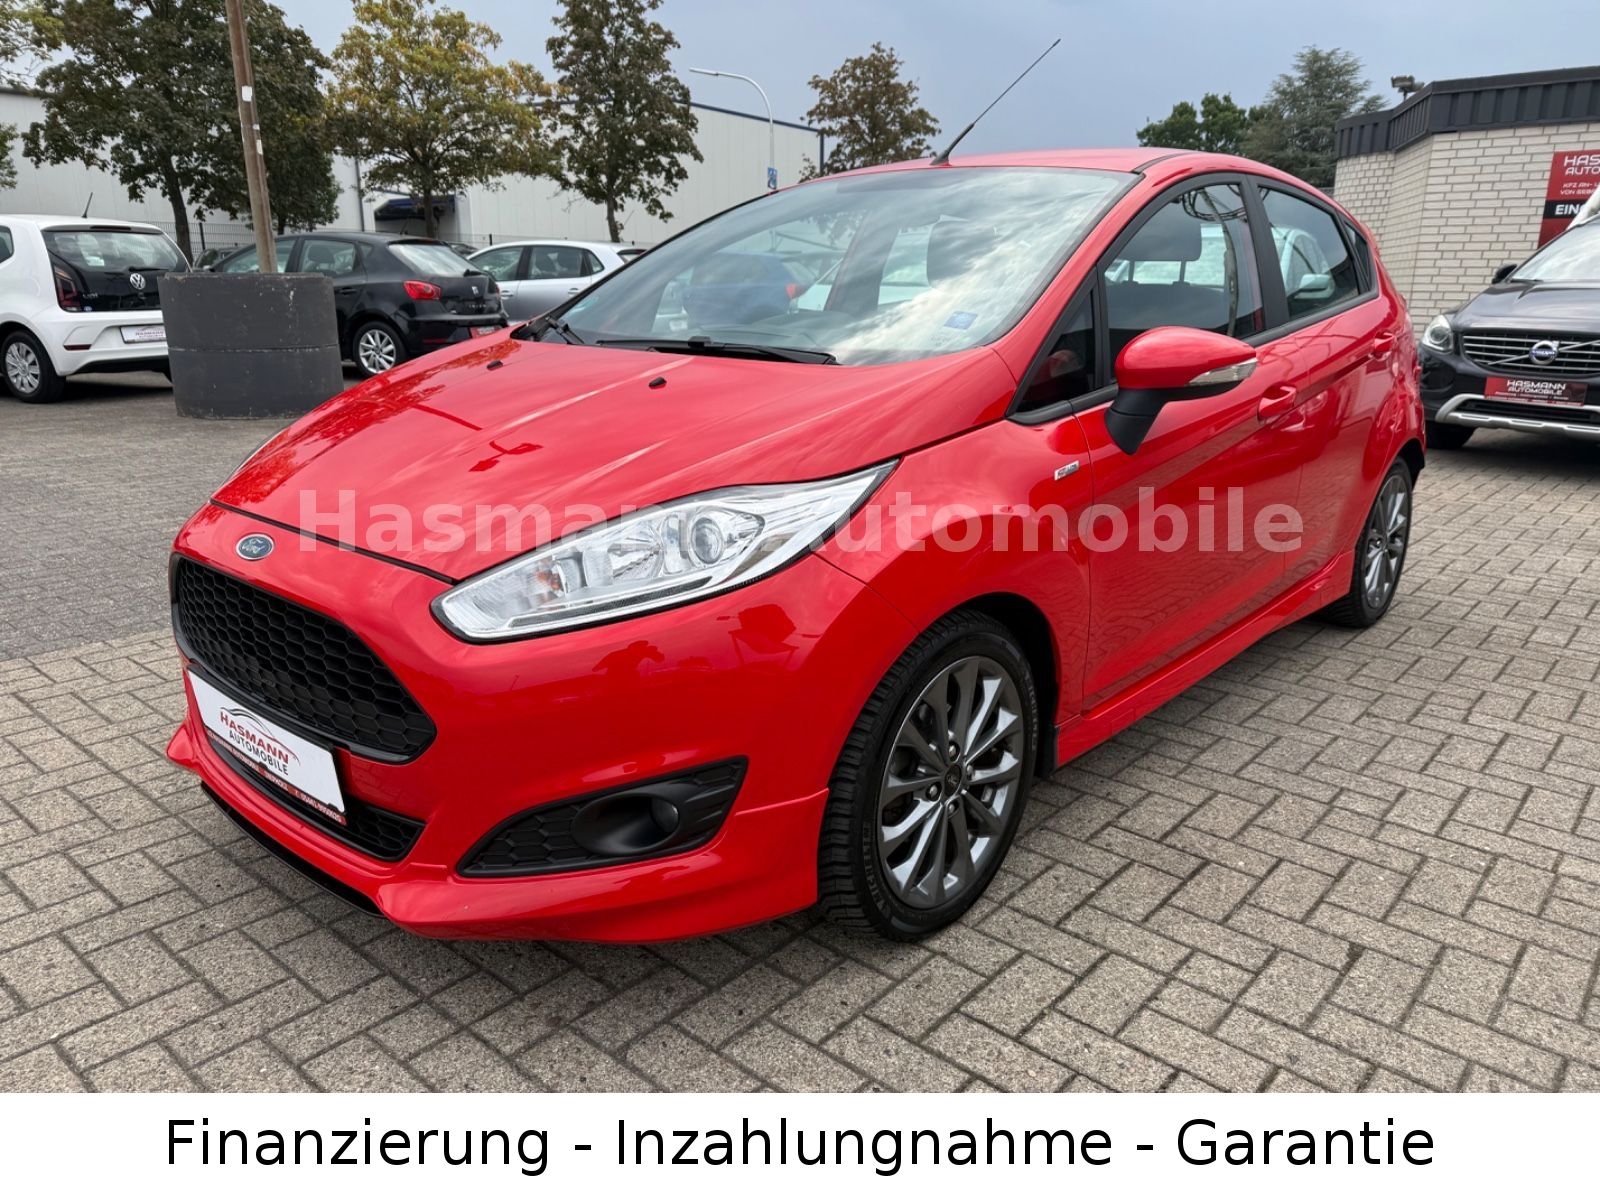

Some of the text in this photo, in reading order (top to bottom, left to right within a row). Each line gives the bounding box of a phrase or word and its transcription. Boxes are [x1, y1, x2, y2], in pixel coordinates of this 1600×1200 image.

[1555, 203, 1582, 215] EIN
[1506, 380, 1567, 390] HASMANN
[1507, 387, 1563, 395] AUTOMOBILE
[220, 711, 289, 764] HASMANN
[229, 730, 289, 776] AUTOMOBILE
